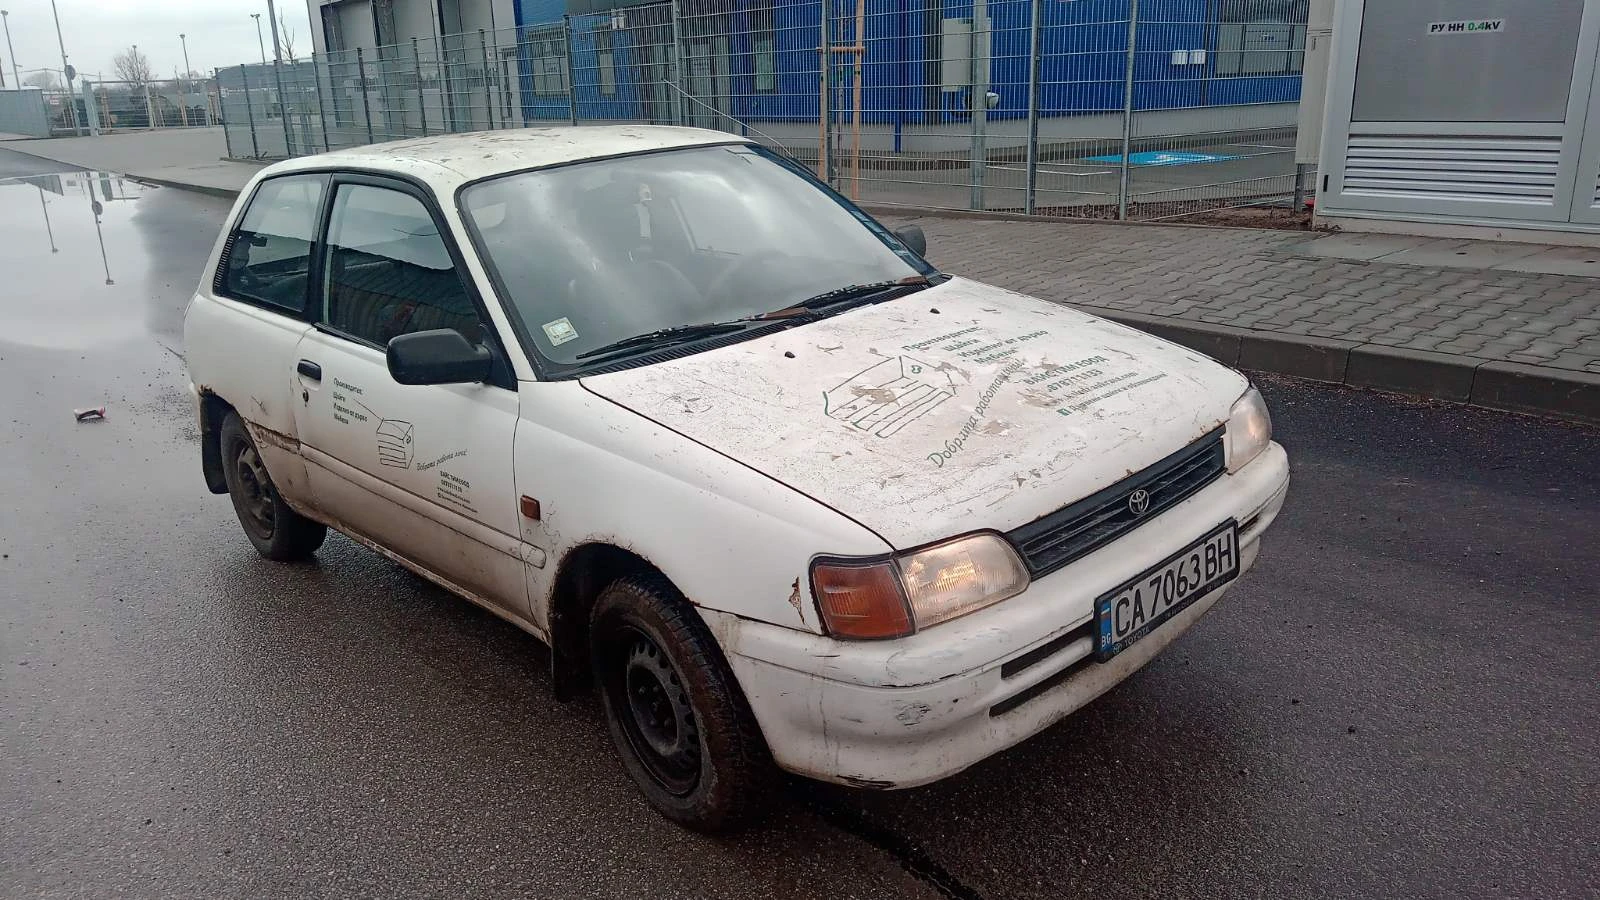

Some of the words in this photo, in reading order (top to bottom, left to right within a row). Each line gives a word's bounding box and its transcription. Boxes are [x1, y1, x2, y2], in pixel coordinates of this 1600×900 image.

[1431, 23, 1445, 33] РУ
[1448, 22, 1464, 32] НН
[1468, 21, 1501, 31] 0.4kV
[1047, 368, 1104, 392] 878711133
[1115, 588, 1145, 638] CA
[1149, 553, 1201, 618] 7063
[1205, 533, 1232, 582] BH
[1101, 632, 1112, 648] BG
